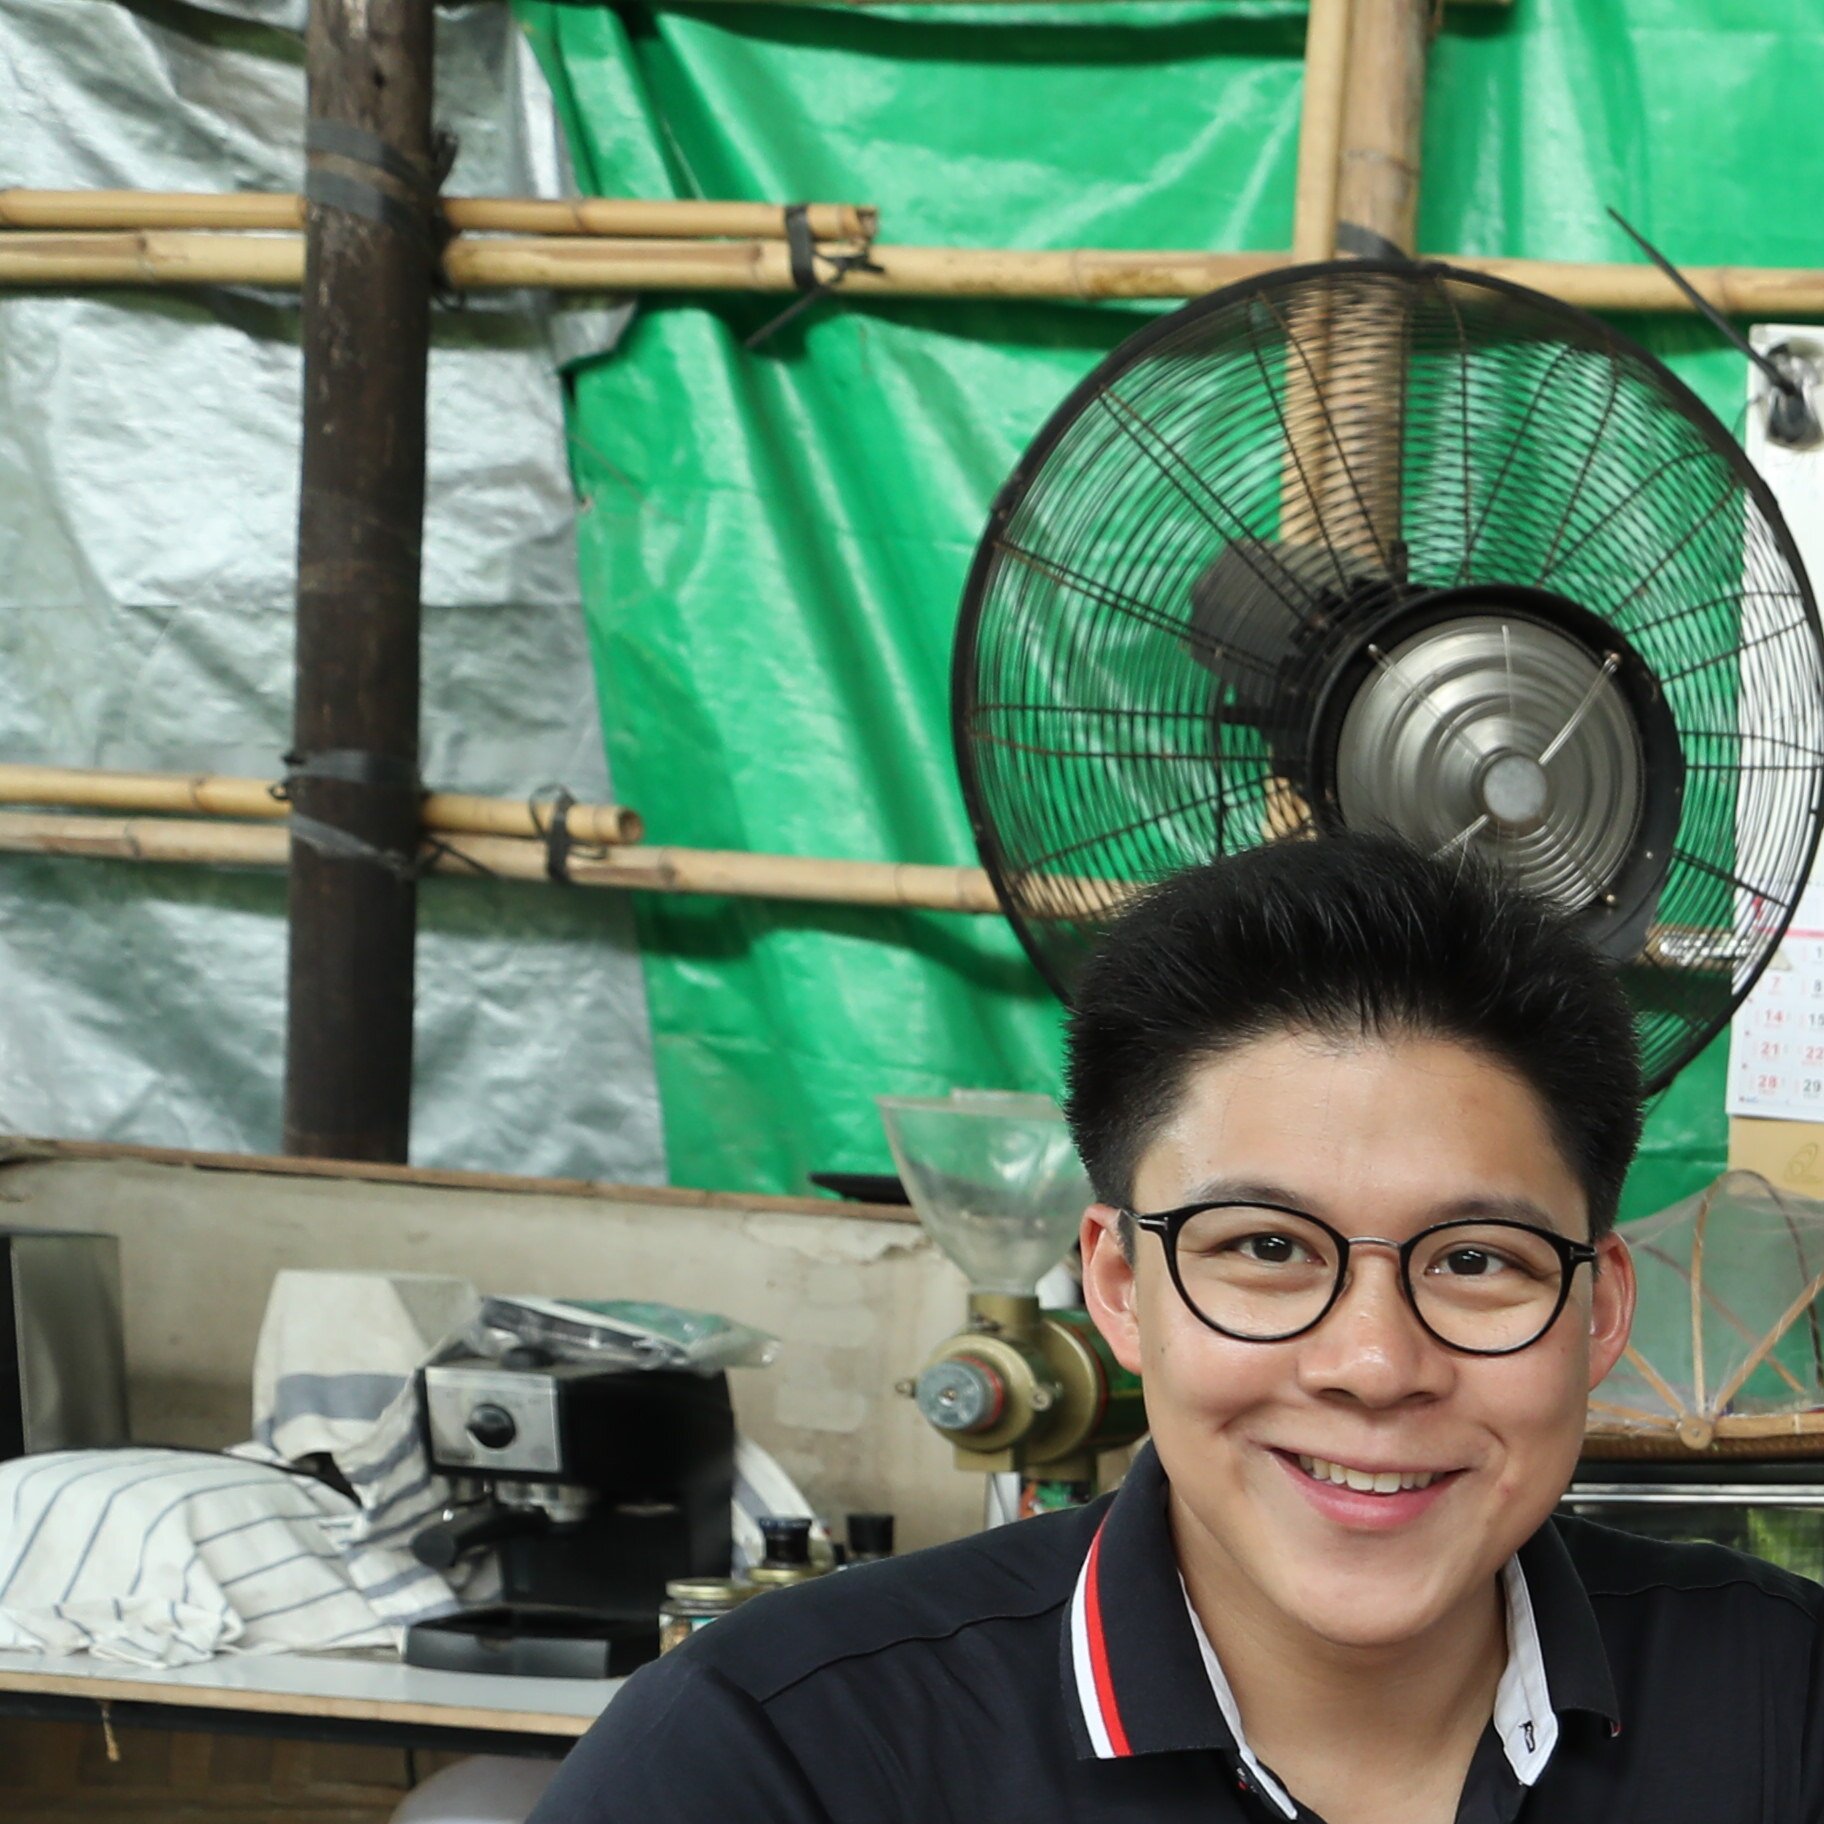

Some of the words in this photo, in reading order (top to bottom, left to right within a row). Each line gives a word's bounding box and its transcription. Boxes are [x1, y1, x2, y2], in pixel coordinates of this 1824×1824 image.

[1765, 1009, 1784, 1023] 14
[1760, 1042, 1779, 1055] 21
[1805, 1046, 1824, 1060] 22
[1758, 1074, 1777, 1089] 28
[1803, 1079, 1822, 1093] 29
